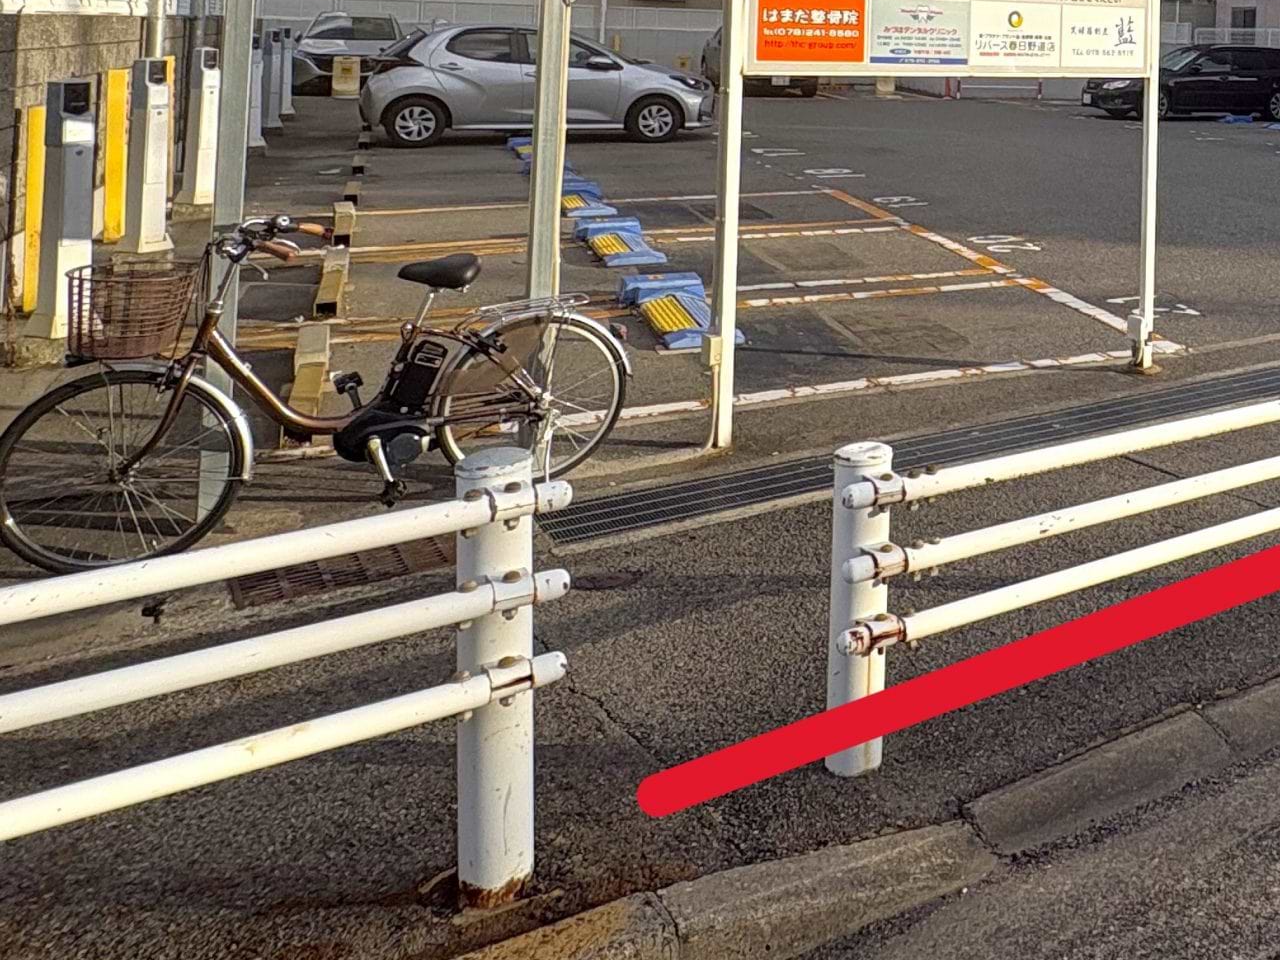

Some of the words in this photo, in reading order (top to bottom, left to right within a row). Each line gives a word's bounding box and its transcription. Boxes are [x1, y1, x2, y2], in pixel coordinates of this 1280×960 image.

[762, 8, 860, 26] はまだ整骨院
